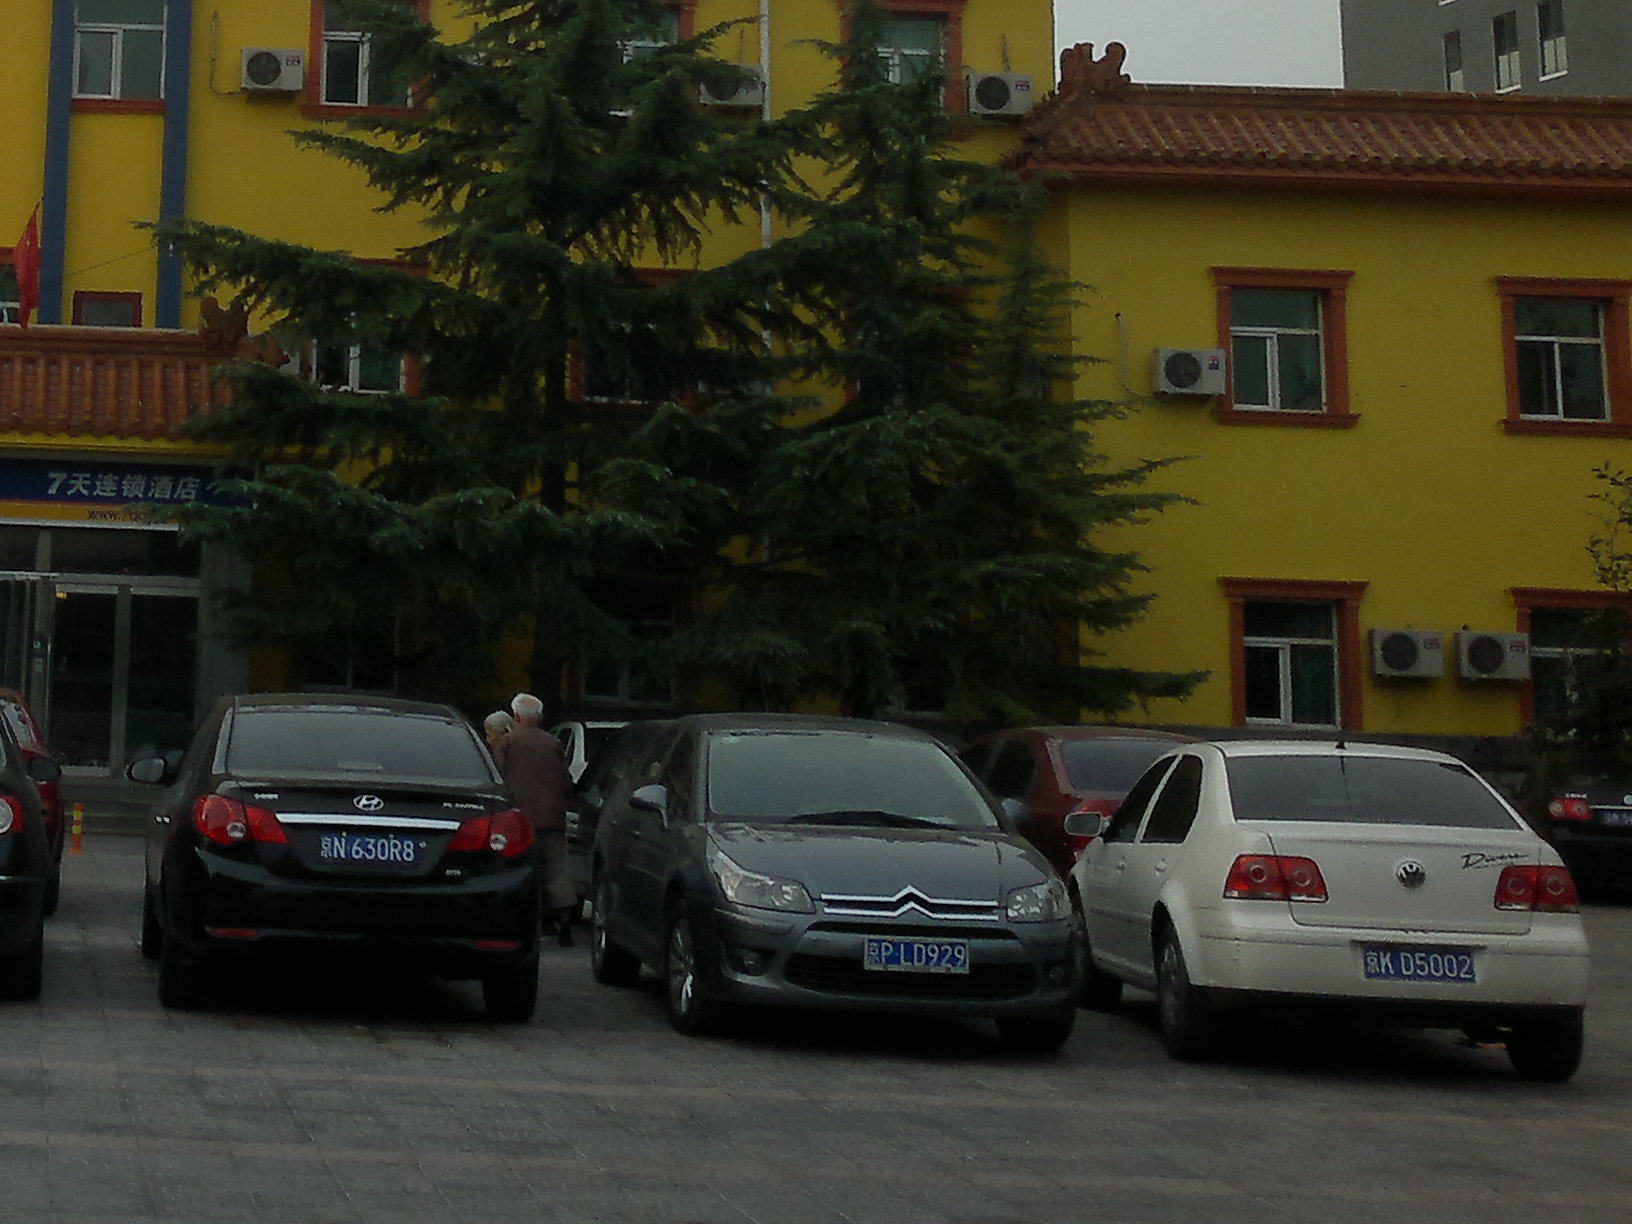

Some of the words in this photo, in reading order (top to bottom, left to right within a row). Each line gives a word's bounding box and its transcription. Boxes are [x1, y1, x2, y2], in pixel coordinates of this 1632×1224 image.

[47, 471, 201, 500] 7天连锁酒店
